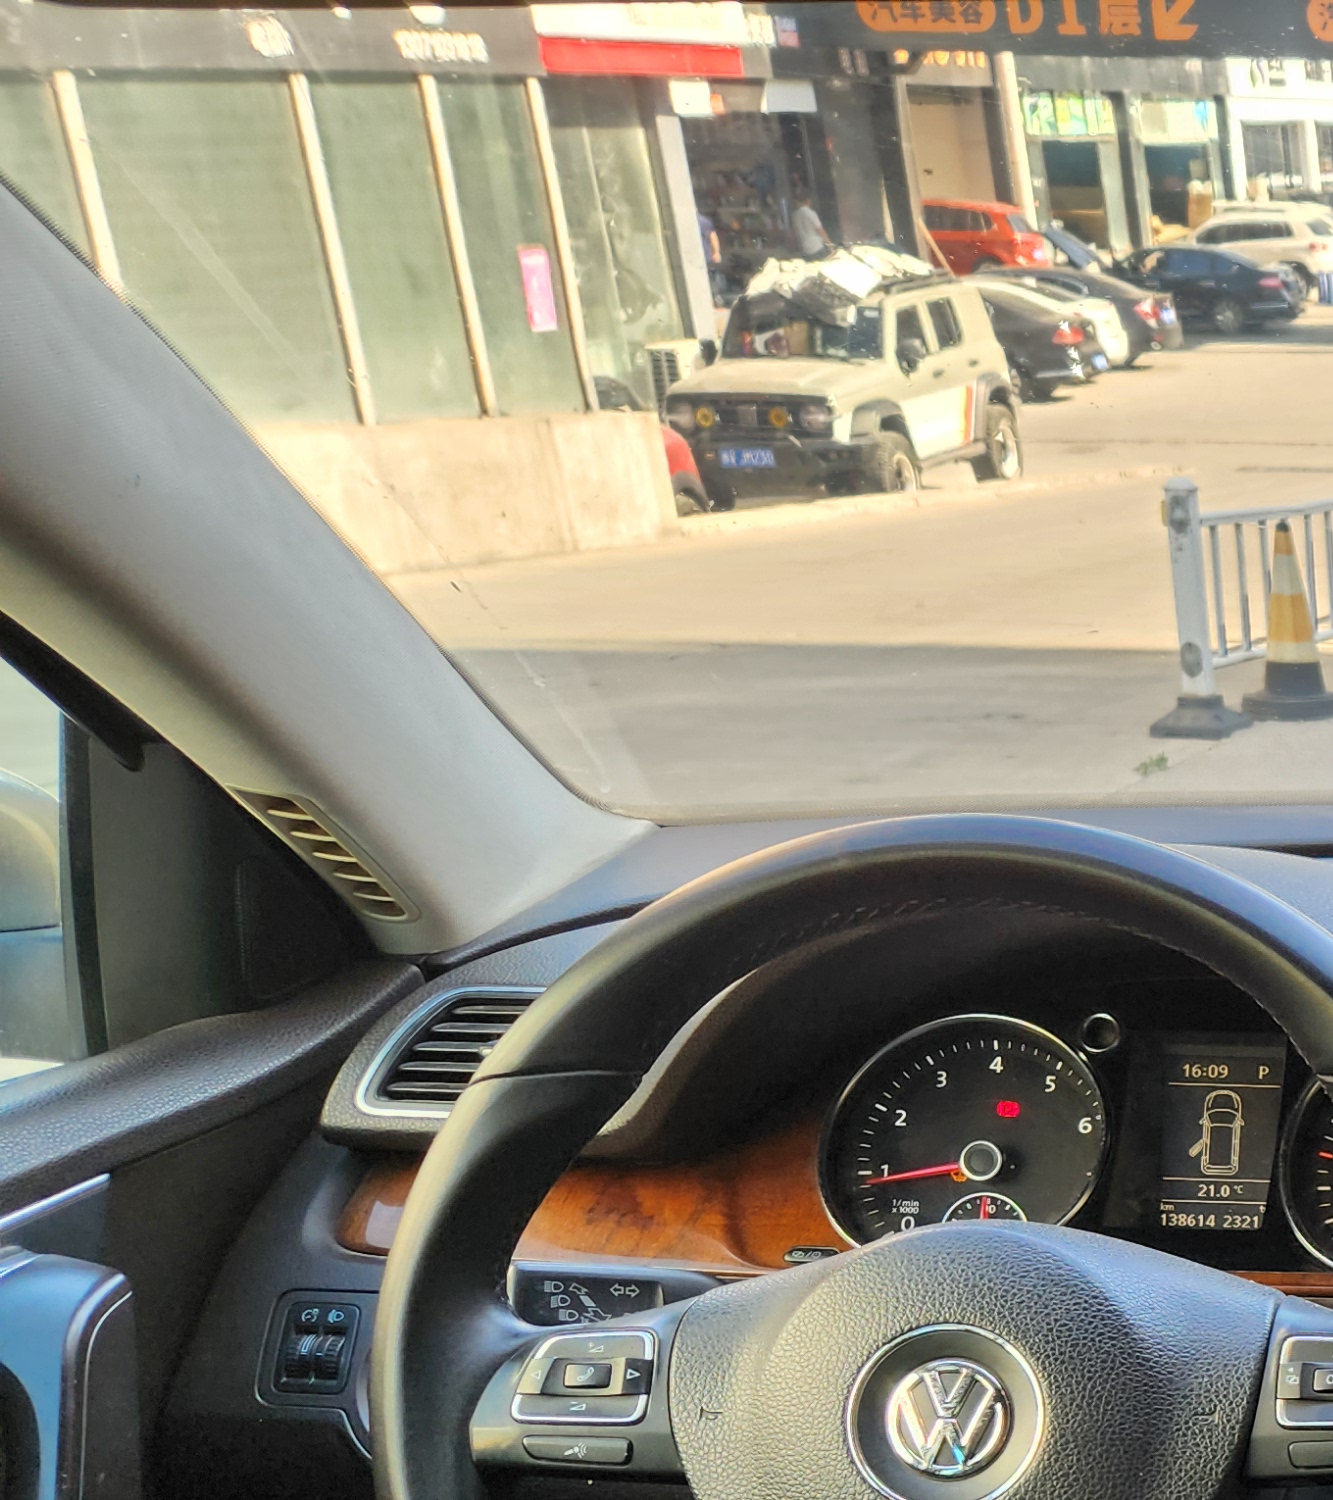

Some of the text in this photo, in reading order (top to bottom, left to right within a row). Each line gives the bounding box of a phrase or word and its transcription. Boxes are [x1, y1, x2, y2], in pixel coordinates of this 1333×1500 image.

[989, 1056, 1003, 1073] 4
[1182, 1063, 1270, 1079] 16:09 P
[936, 1071, 947, 1088] 3
[1044, 1075, 1056, 1092] 5
[894, 1109, 907, 1126] 2
[1078, 1117, 1093, 1134] 6
[880, 1164, 889, 1178] 1
[1197, 1184, 1231, 1198] 21.0
[892, 1199, 919, 1207] 1/min
[1160, 1203, 1174, 1211] km
[901, 1216, 915, 1231] 0
[1160, 1213, 1260, 1229] 138614 2321
